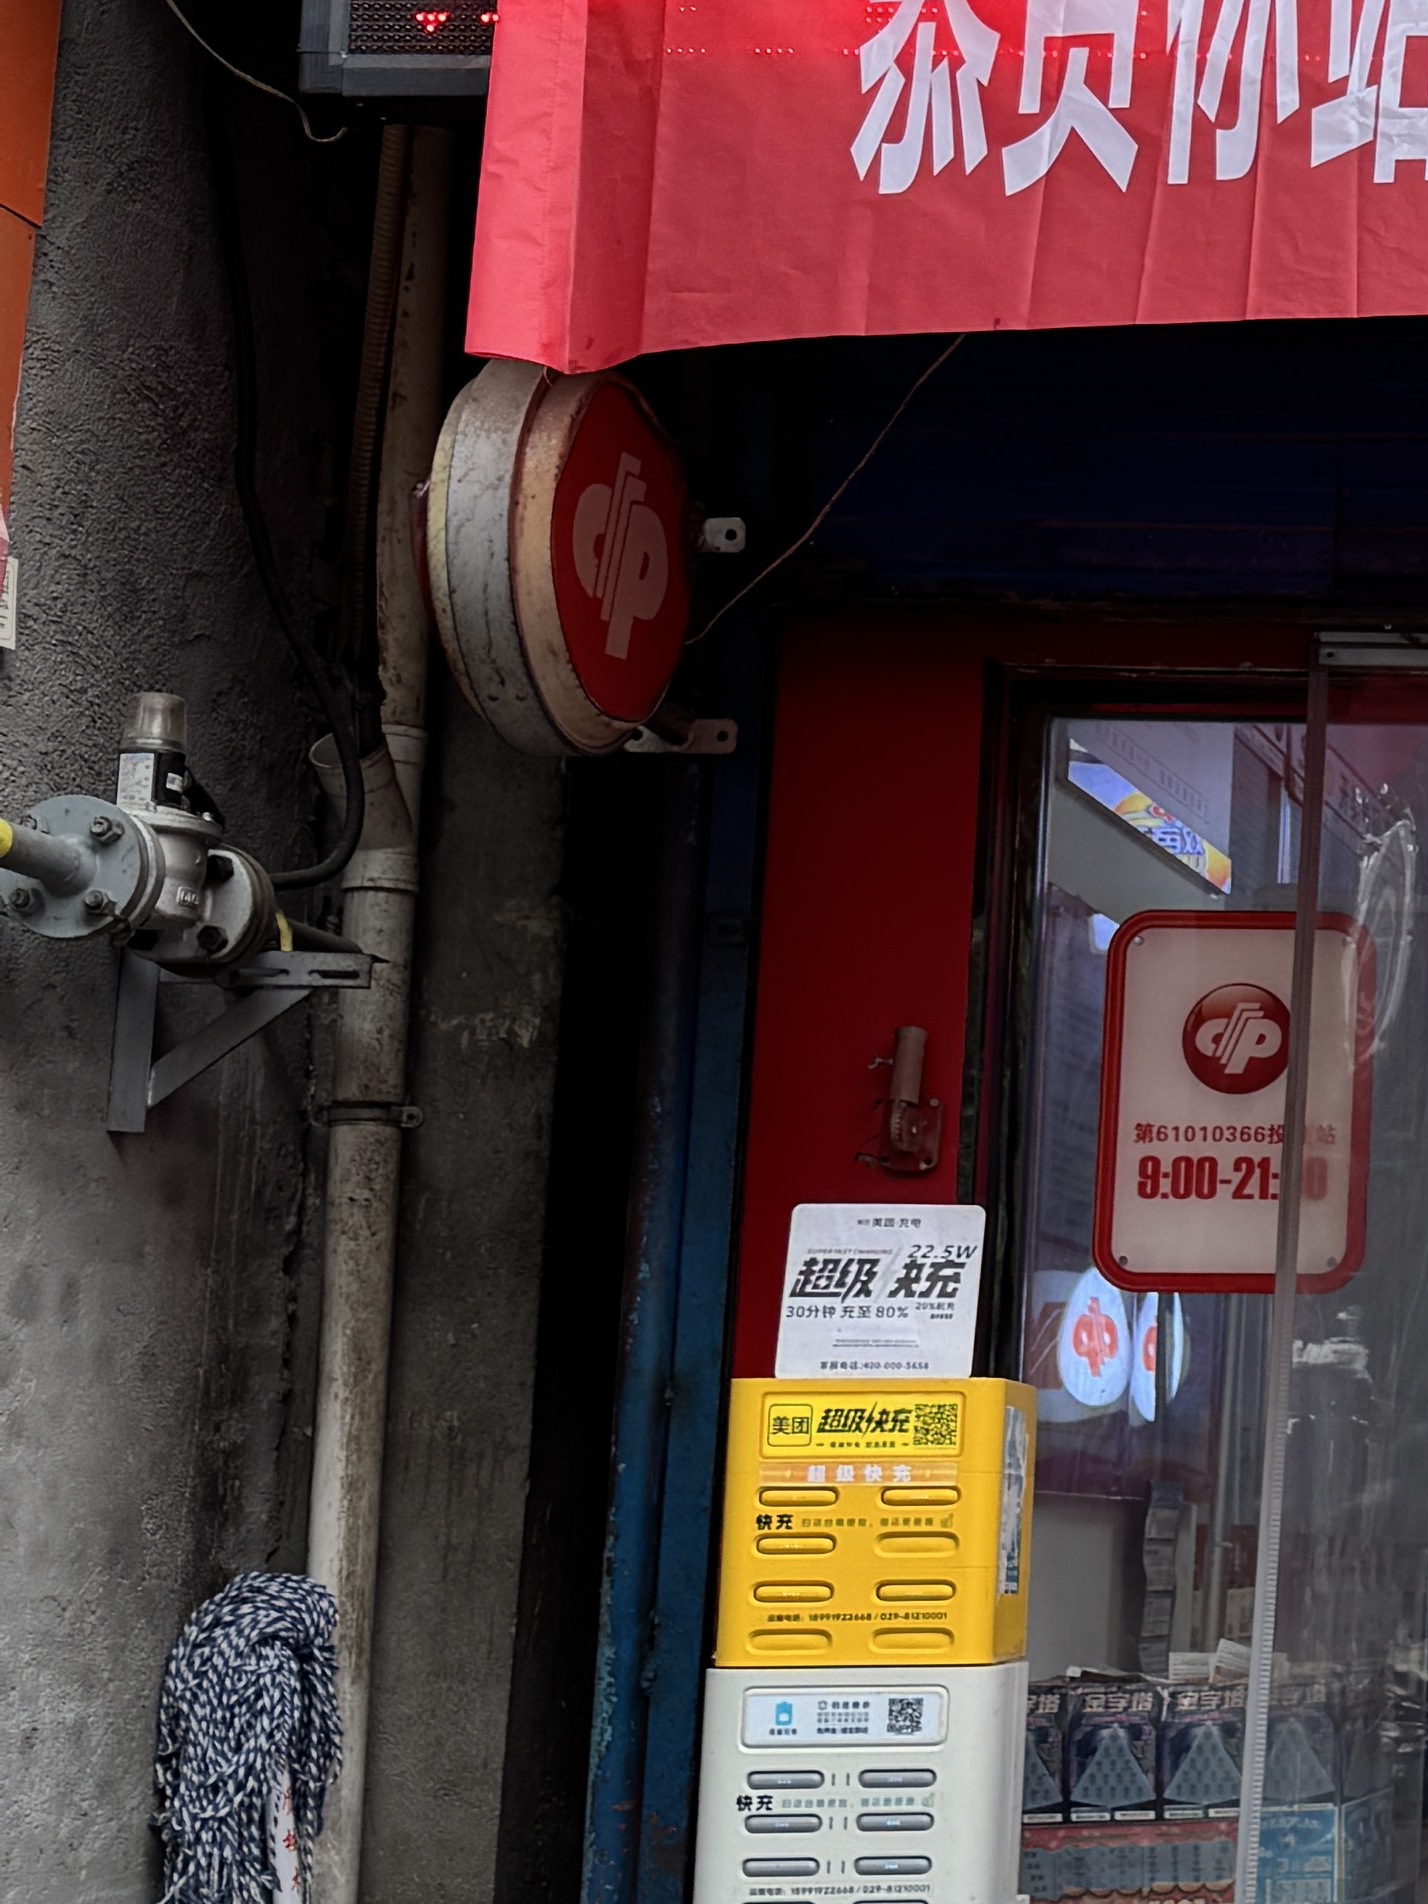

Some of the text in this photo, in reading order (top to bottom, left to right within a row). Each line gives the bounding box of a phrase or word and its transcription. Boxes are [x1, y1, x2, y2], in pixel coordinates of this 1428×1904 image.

[1133, 1122, 1336, 1145] 第61010366投站
[1136, 1154, 1328, 1201] 9:00-21:0
[907, 1244, 978, 1259] 22.5W
[771, 1415, 810, 1436] 美团
[755, 1513, 794, 1530] 快充
[736, 1794, 774, 1812] 快充
